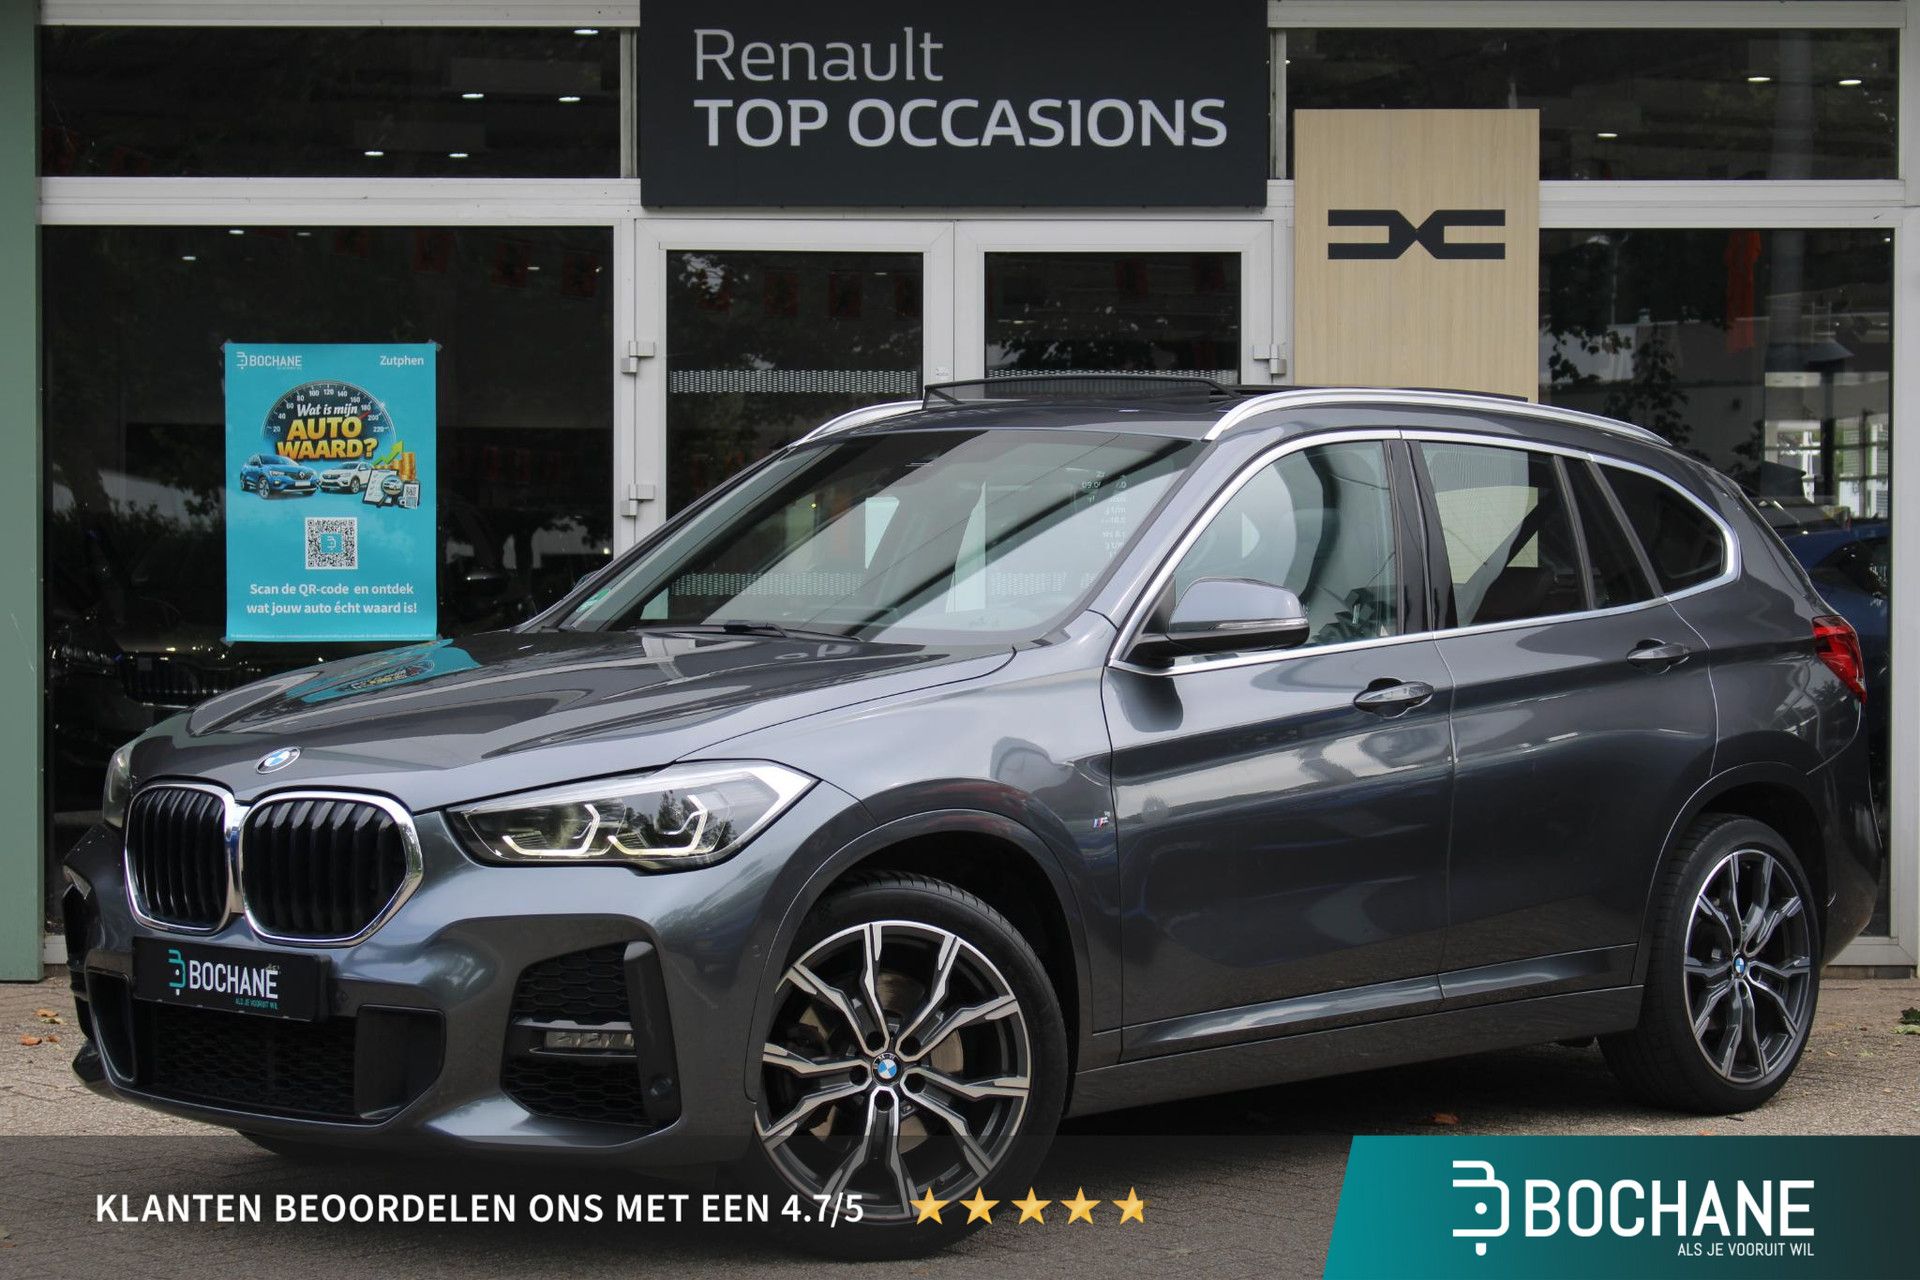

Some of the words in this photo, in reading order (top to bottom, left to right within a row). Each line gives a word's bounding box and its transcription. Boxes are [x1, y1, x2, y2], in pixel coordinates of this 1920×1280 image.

[694, 27, 944, 81] Renault
[694, 98, 828, 147] TOP
[848, 98, 1227, 148] OCCASIONS
[249, 355, 302, 367] BOCHANE
[380, 355, 425, 368] Zutphen
[296, 403, 321, 417] Wat
[323, 403, 332, 416] is
[334, 403, 358, 418] mijn
[287, 416, 362, 441] AUTO
[277, 437, 378, 460] WAARD?
[249, 583, 277, 595] Scan
[281, 583, 296, 595] de
[298, 583, 349, 597] QR-code
[354, 585, 369, 595] en
[371, 583, 414, 595] ontdek
[246, 604, 270, 614] wat
[271, 603, 301, 616] jouw
[304, 604, 332, 614] auto
[334, 601, 360, 614] écht
[362, 602, 401, 614] waard
[403, 602, 417, 614] is!
[189, 959, 279, 999] BOCHANE
